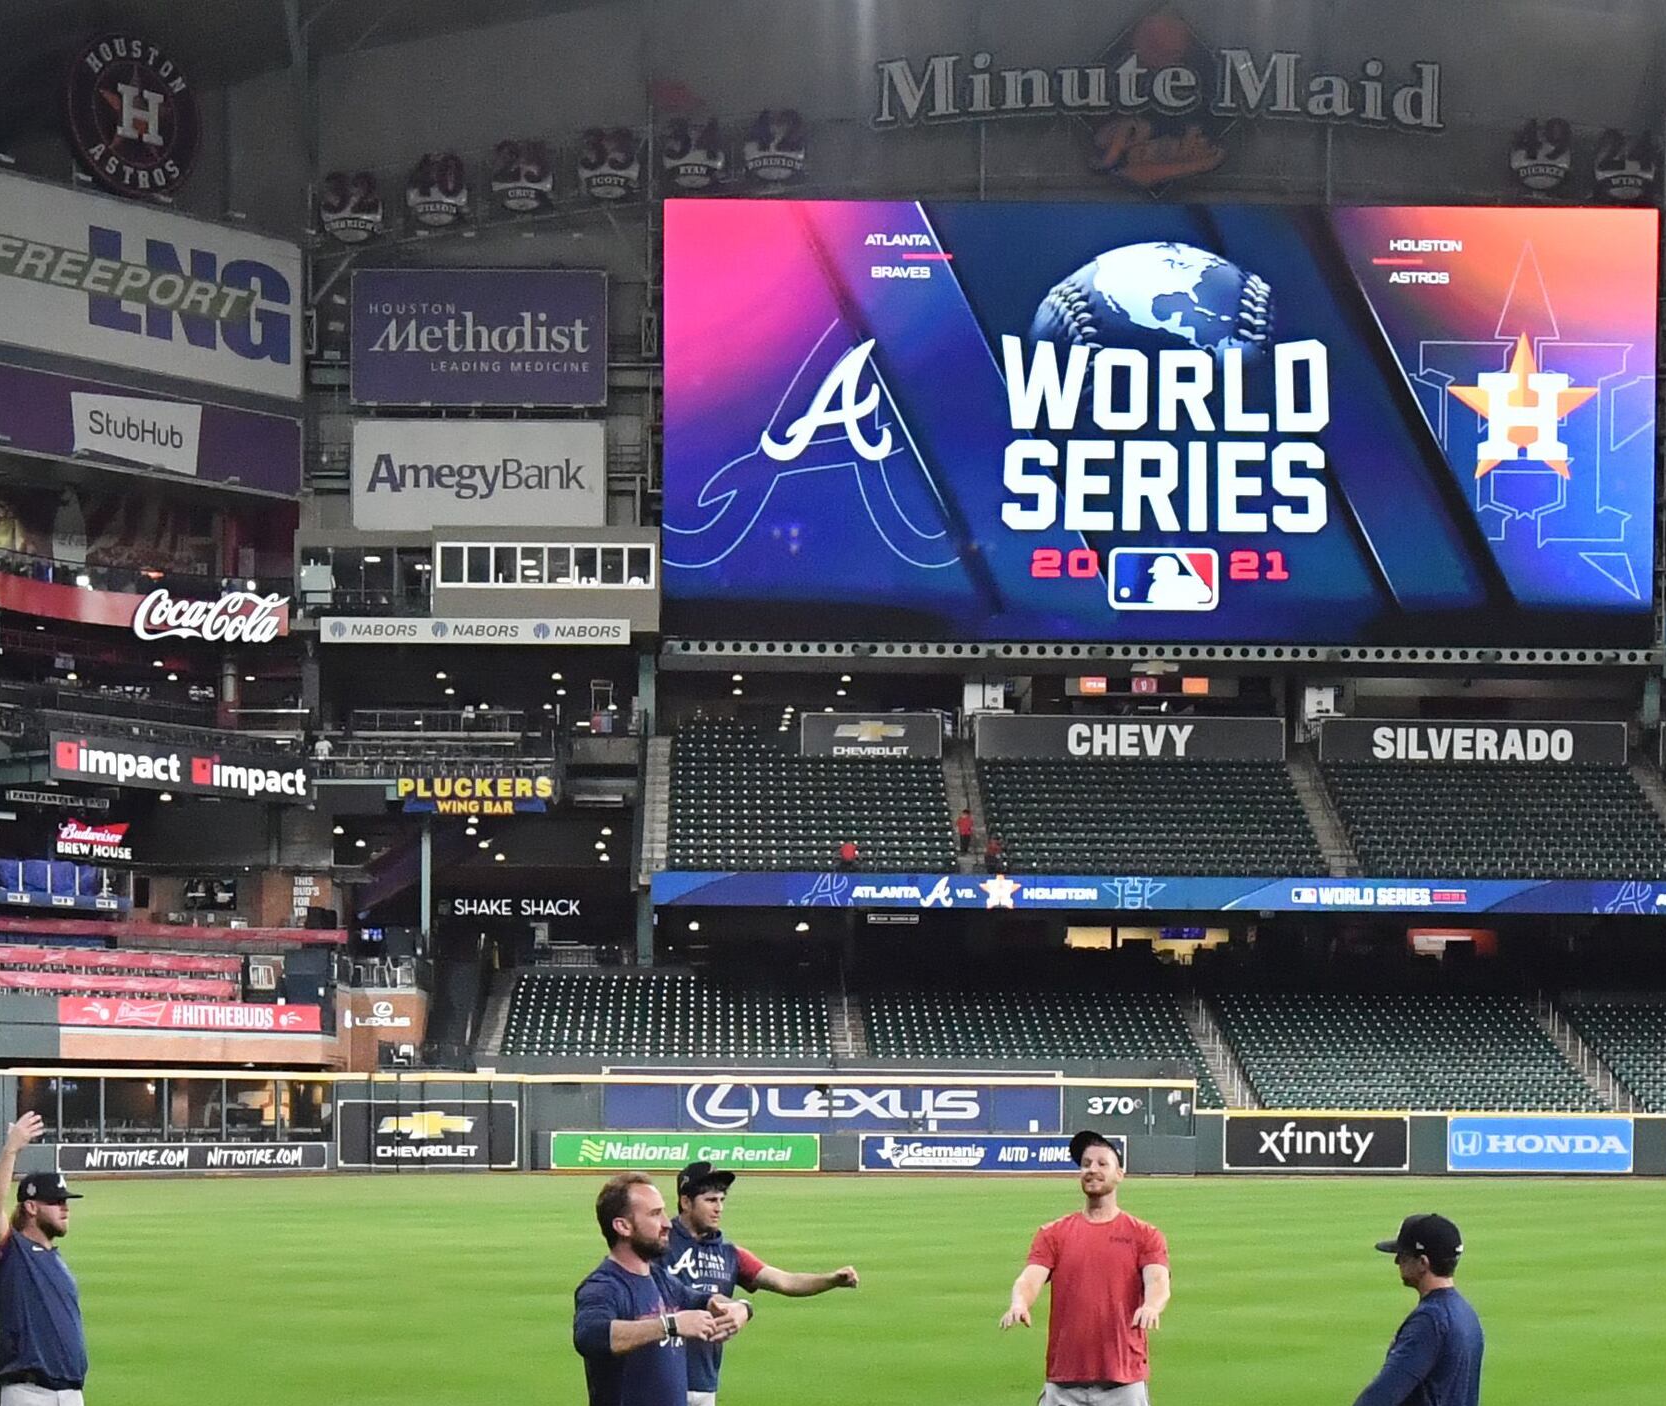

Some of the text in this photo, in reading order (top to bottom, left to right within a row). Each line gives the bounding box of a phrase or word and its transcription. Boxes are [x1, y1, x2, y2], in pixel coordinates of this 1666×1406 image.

[85, 37, 187, 94] HOUSTON
[878, 48, 1445, 130] Minute Maid
[88, 142, 181, 190] ASTROS
[678, 165, 708, 176] RYAN
[864, 234, 932, 247] ATLANTA
[1388, 238, 1463, 253] HOUSTON
[870, 266, 931, 280] BRAVES
[1388, 271, 1450, 284] ASTROS
[88, 224, 291, 366] LNG
[368, 303, 456, 316] HOUSTON
[368, 311, 591, 354] Methodist
[430, 361, 590, 373] LEADING MEDICINE
[1000, 334, 1330, 434] WORLD
[88, 409, 183, 449] StubHub
[1000, 441, 1328, 534] SERIES
[1030, 550, 1289, 581] 20 21
[132, 587, 291, 644] Coca-Cola
[350, 624, 418, 638] NABORS
[452, 624, 520, 639] NABORS
[554, 625, 622, 639] NABORS
[1066, 722, 1194, 758] CHEVY
[1371, 726, 1574, 762] SILVERADO
[832, 745, 909, 756] CHEVROLET
[79, 740, 181, 783] impact
[211, 754, 307, 796] impact
[397, 777, 553, 800] PLUCKERS
[436, 800, 514, 814] WING BAR
[58, 822, 122, 844] Budweiser
[56, 841, 133, 860] BREW HOUSE
[293, 876, 314, 886] THIS
[293, 886, 320, 897] BUD'S
[851, 885, 921, 900] ATLANTA
[1022, 888, 1098, 901] HOUSTON
[1318, 887, 1375, 906] WORLD
[1376, 887, 1432, 906] SERIES
[293, 897, 310, 907] FOR
[452, 899, 581, 917] SHAKE SHACK
[171, 1000, 275, 1030] #HITTHEBUDS
[355, 1016, 411, 1027] LEXUS
[767, 1088, 981, 1119] LEXUS
[1087, 1096, 1133, 1116] 370
[1259, 1121, 1375, 1161] xfinity
[1485, 1135, 1627, 1155] HONDA
[85, 1146, 189, 1169] NITTOTIRE.COM
[206, 1146, 303, 1167] NITTOTIRE.COM
[376, 1144, 478, 1158] CHEVROLET
[605, 1140, 792, 1163] National Car Rental
[908, 1143, 985, 1161] Germania
[997, 1146, 1071, 1163] AUTO HOME
